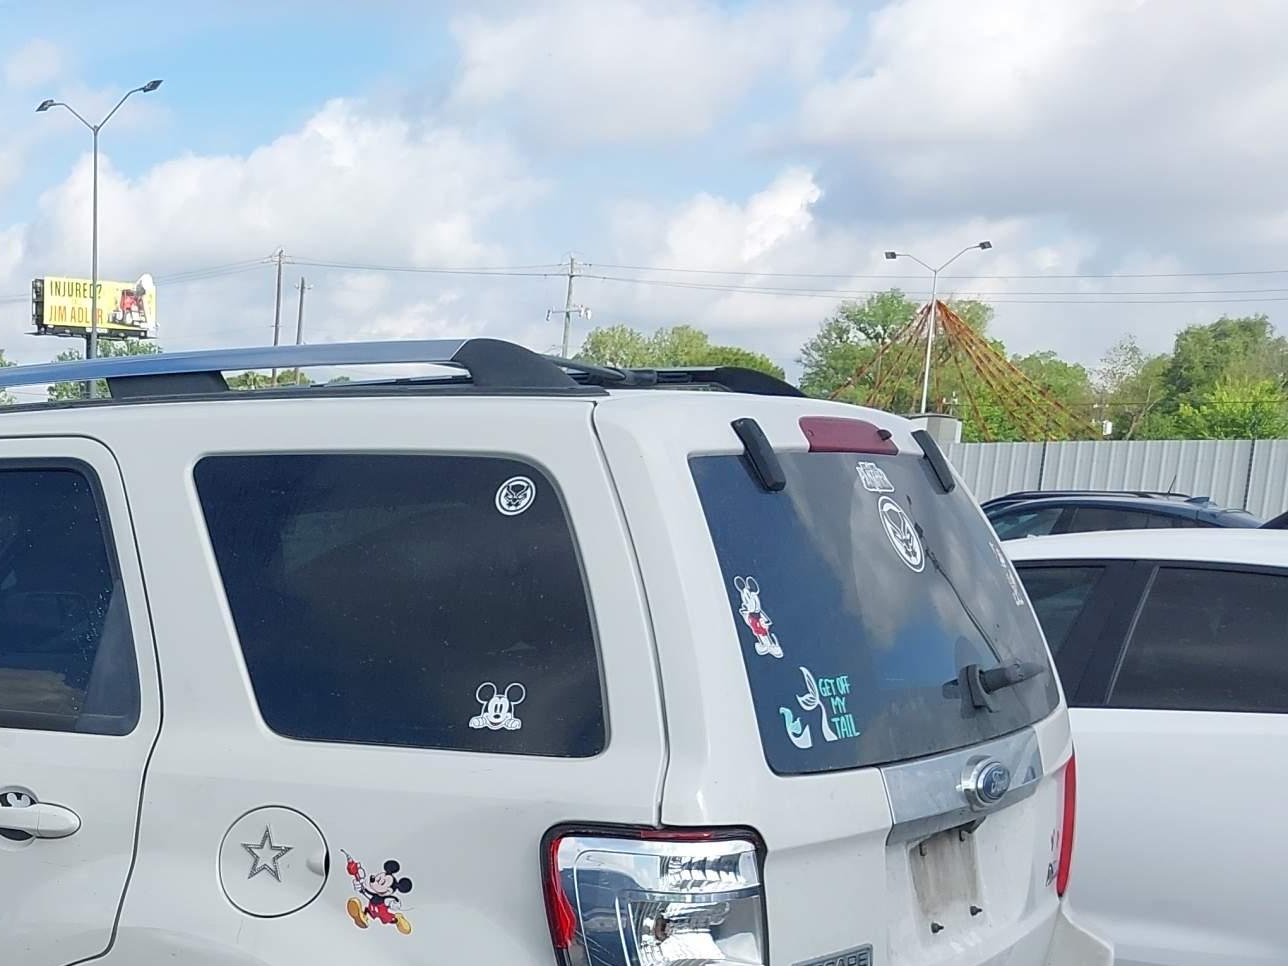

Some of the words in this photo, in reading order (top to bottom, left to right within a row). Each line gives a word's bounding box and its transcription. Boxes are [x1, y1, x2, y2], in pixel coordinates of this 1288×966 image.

[49, 304, 67, 322] JIM
[71, 306, 103, 325] ADLR
[818, 678, 836, 696] GET
[836, 675, 851, 695] OFF
[831, 697, 846, 714] MY
[831, 714, 860, 739] TAIL
